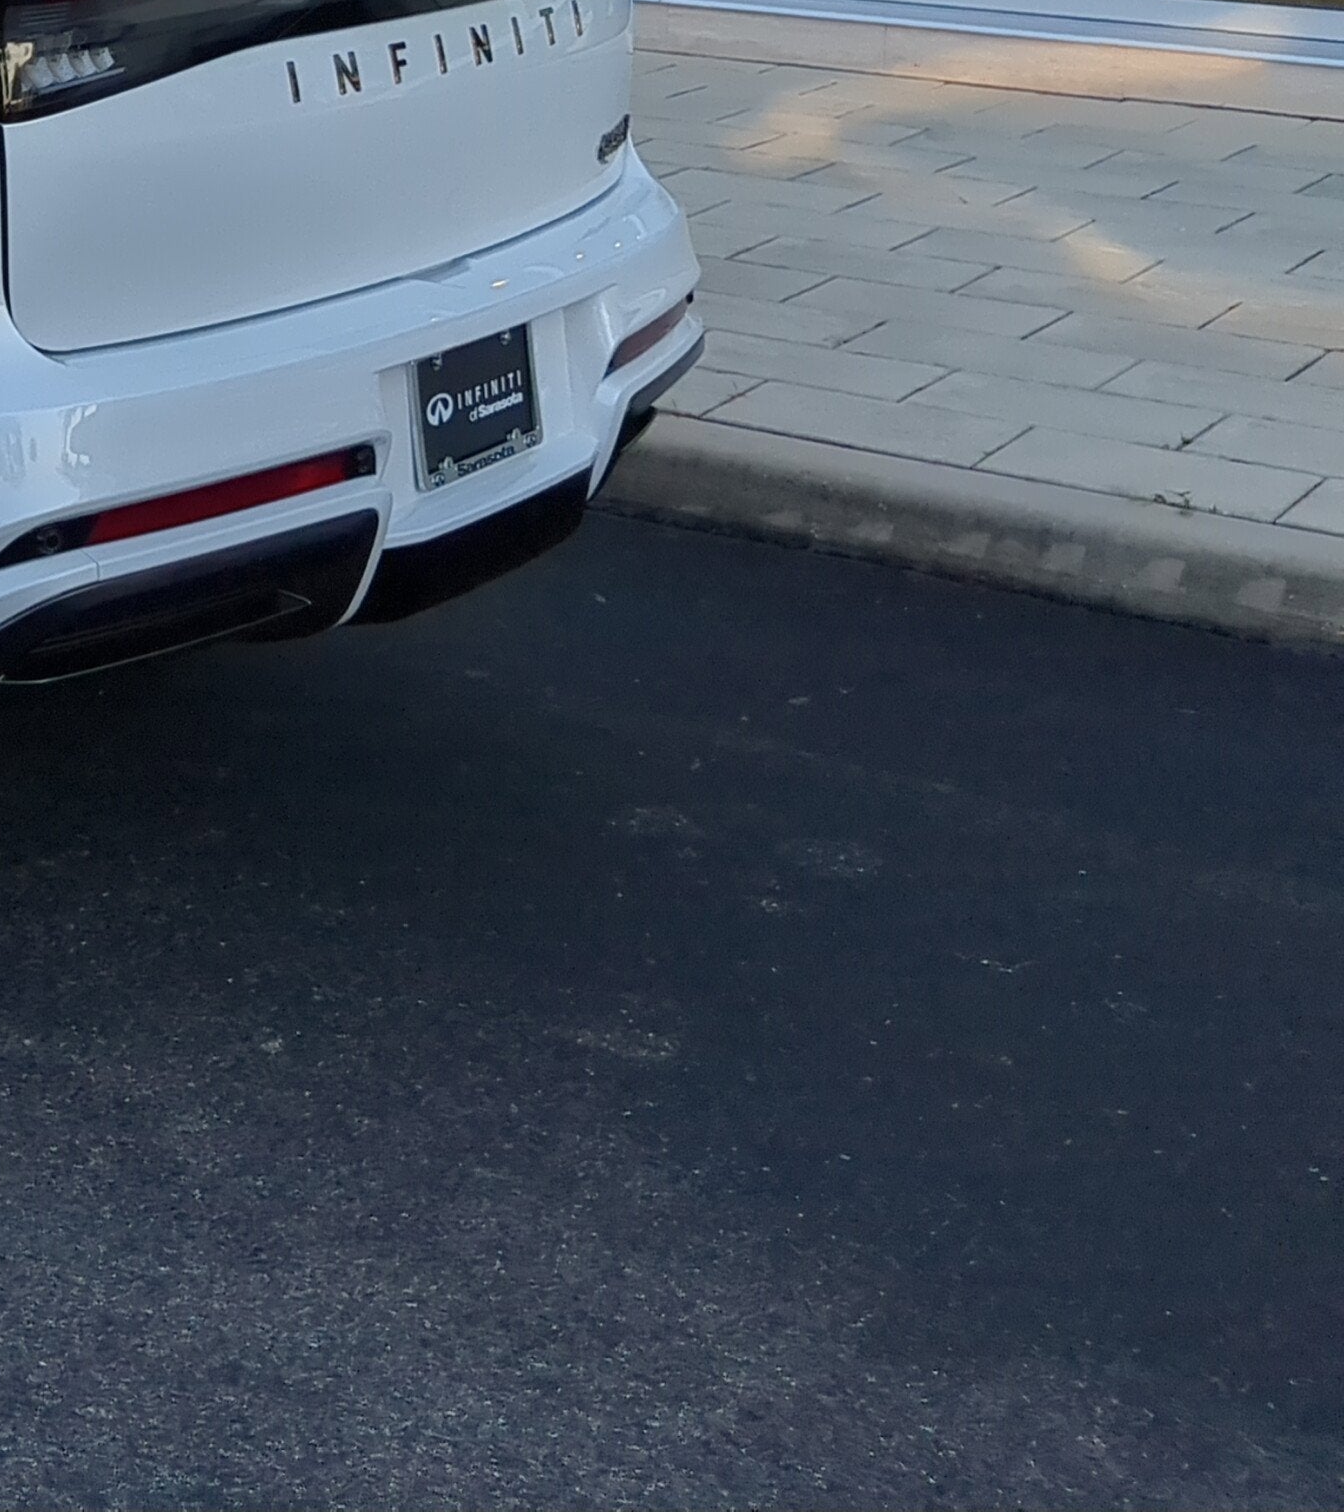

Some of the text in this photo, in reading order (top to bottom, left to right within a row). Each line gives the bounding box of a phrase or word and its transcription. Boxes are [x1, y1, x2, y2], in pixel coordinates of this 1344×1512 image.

[285, 0, 584, 104] INFINITI
[457, 369, 522, 410] INFINITI
[469, 391, 524, 422] of Sarasota
[457, 445, 515, 477] Sarasota
